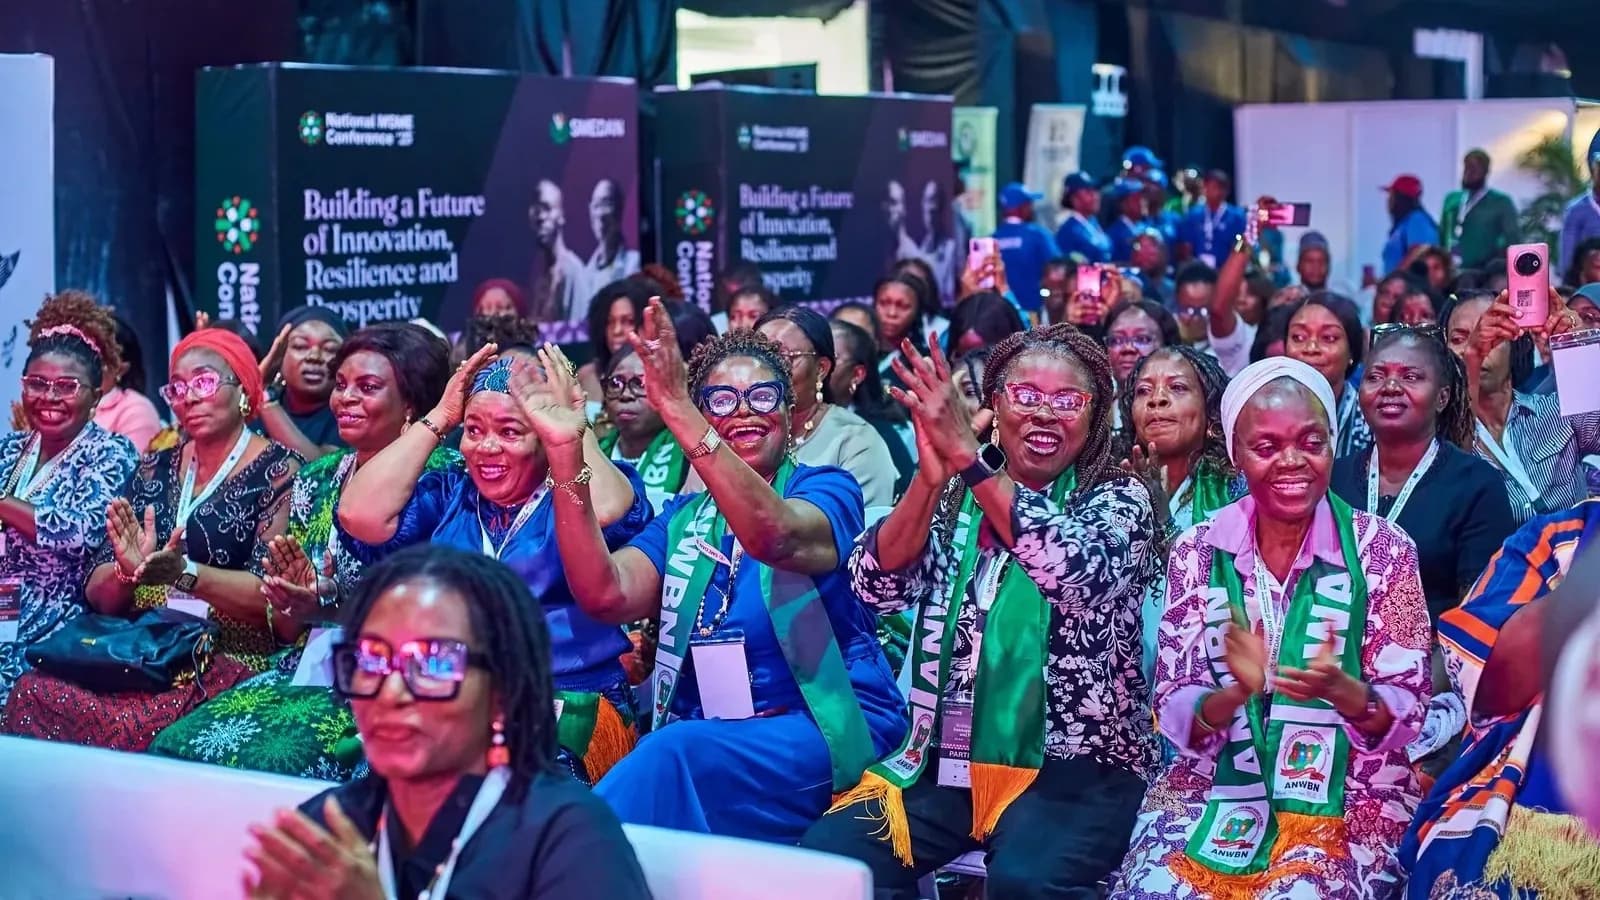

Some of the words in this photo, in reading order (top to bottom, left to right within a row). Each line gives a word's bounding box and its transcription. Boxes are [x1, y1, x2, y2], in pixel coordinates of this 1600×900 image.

[303, 187, 400, 228] Building
[400, 197, 415, 219] a
[417, 187, 487, 218] Future
[302, 223, 330, 256] of
[332, 222, 454, 255] Innovation,
[305, 256, 417, 291] Resilience
[418, 252, 459, 285] and
[1284, 780, 1320, 793] ANWBN
[1211, 848, 1249, 858] ANWBN
